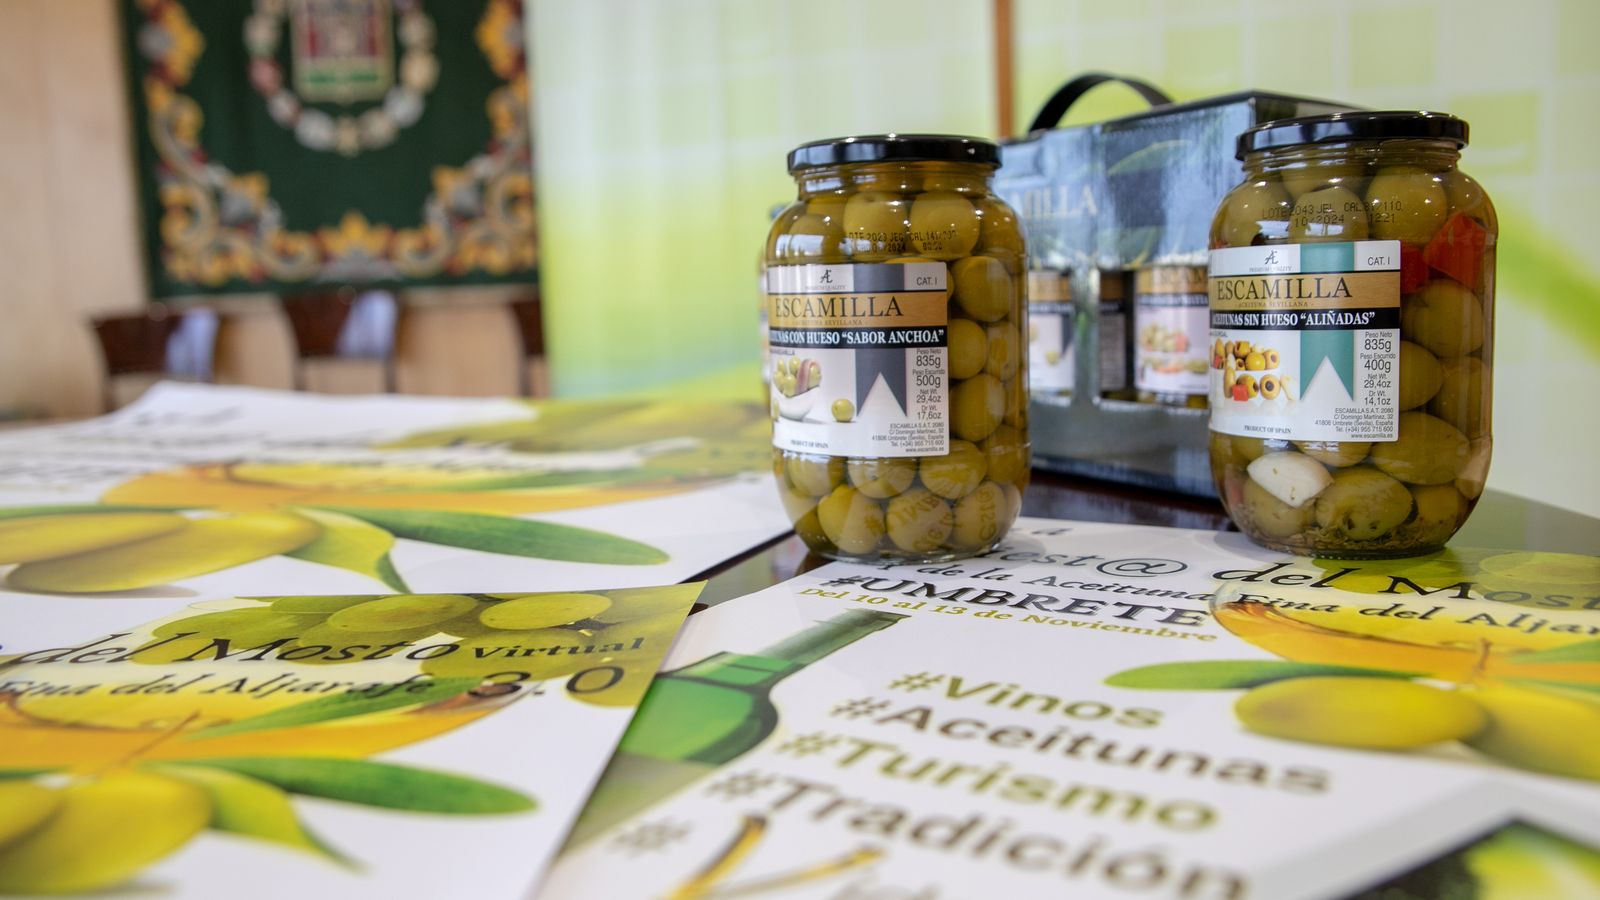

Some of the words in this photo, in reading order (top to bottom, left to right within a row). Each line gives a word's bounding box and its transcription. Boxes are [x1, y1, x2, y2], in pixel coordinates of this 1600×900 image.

[1367, 257, 1386, 266] CAT.
[1387, 257, 1391, 265] I
[916, 277, 933, 286] CAT.
[1217, 277, 1353, 300] ESCAMILLA
[775, 296, 904, 318] ESCAMILLA
[1244, 313, 1260, 326] SIN
[1261, 313, 1298, 326] HUESO
[789, 331, 806, 344] CON
[806, 331, 840, 344] HUESO
[1364, 339, 1391, 353] 835g
[916, 355, 941, 368] 835g
[1364, 359, 1391, 373] 400g
[916, 375, 941, 388] 500g
[1364, 380, 1391, 389] 29,4oz
[916, 395, 941, 404] 29,4oz
[1364, 397, 1391, 406] 14,1oz
[918, 412, 942, 420] 17,6oz
[1212, 562, 1361, 588] del
[819, 574, 1213, 628] #UMBRETE
[917, 564, 965, 576] de
[970, 568, 1013, 581] la
[1020, 575, 1217, 601] Aceituna
[1234, 593, 1340, 613] Fina
[1358, 603, 1446, 620] del
[799, 587, 851, 600] Del
[850, 594, 888, 605] 10
[892, 601, 928, 612] al
[930, 604, 968, 615] 13
[973, 610, 1014, 620] de
[1018, 613, 1218, 642] Noviembre
[12, 631, 200, 664] del
[173, 637, 461, 664] Mosto
[471, 637, 645, 660] Virtual
[109, 673, 216, 694] del
[199, 672, 434, 699] Aljarafe
[888, 671, 1165, 730] #Vinos
[828, 694, 1336, 796] #Aceitunas
[774, 730, 1221, 832] #Turismo
[706, 767, 1250, 900] #Tradición
